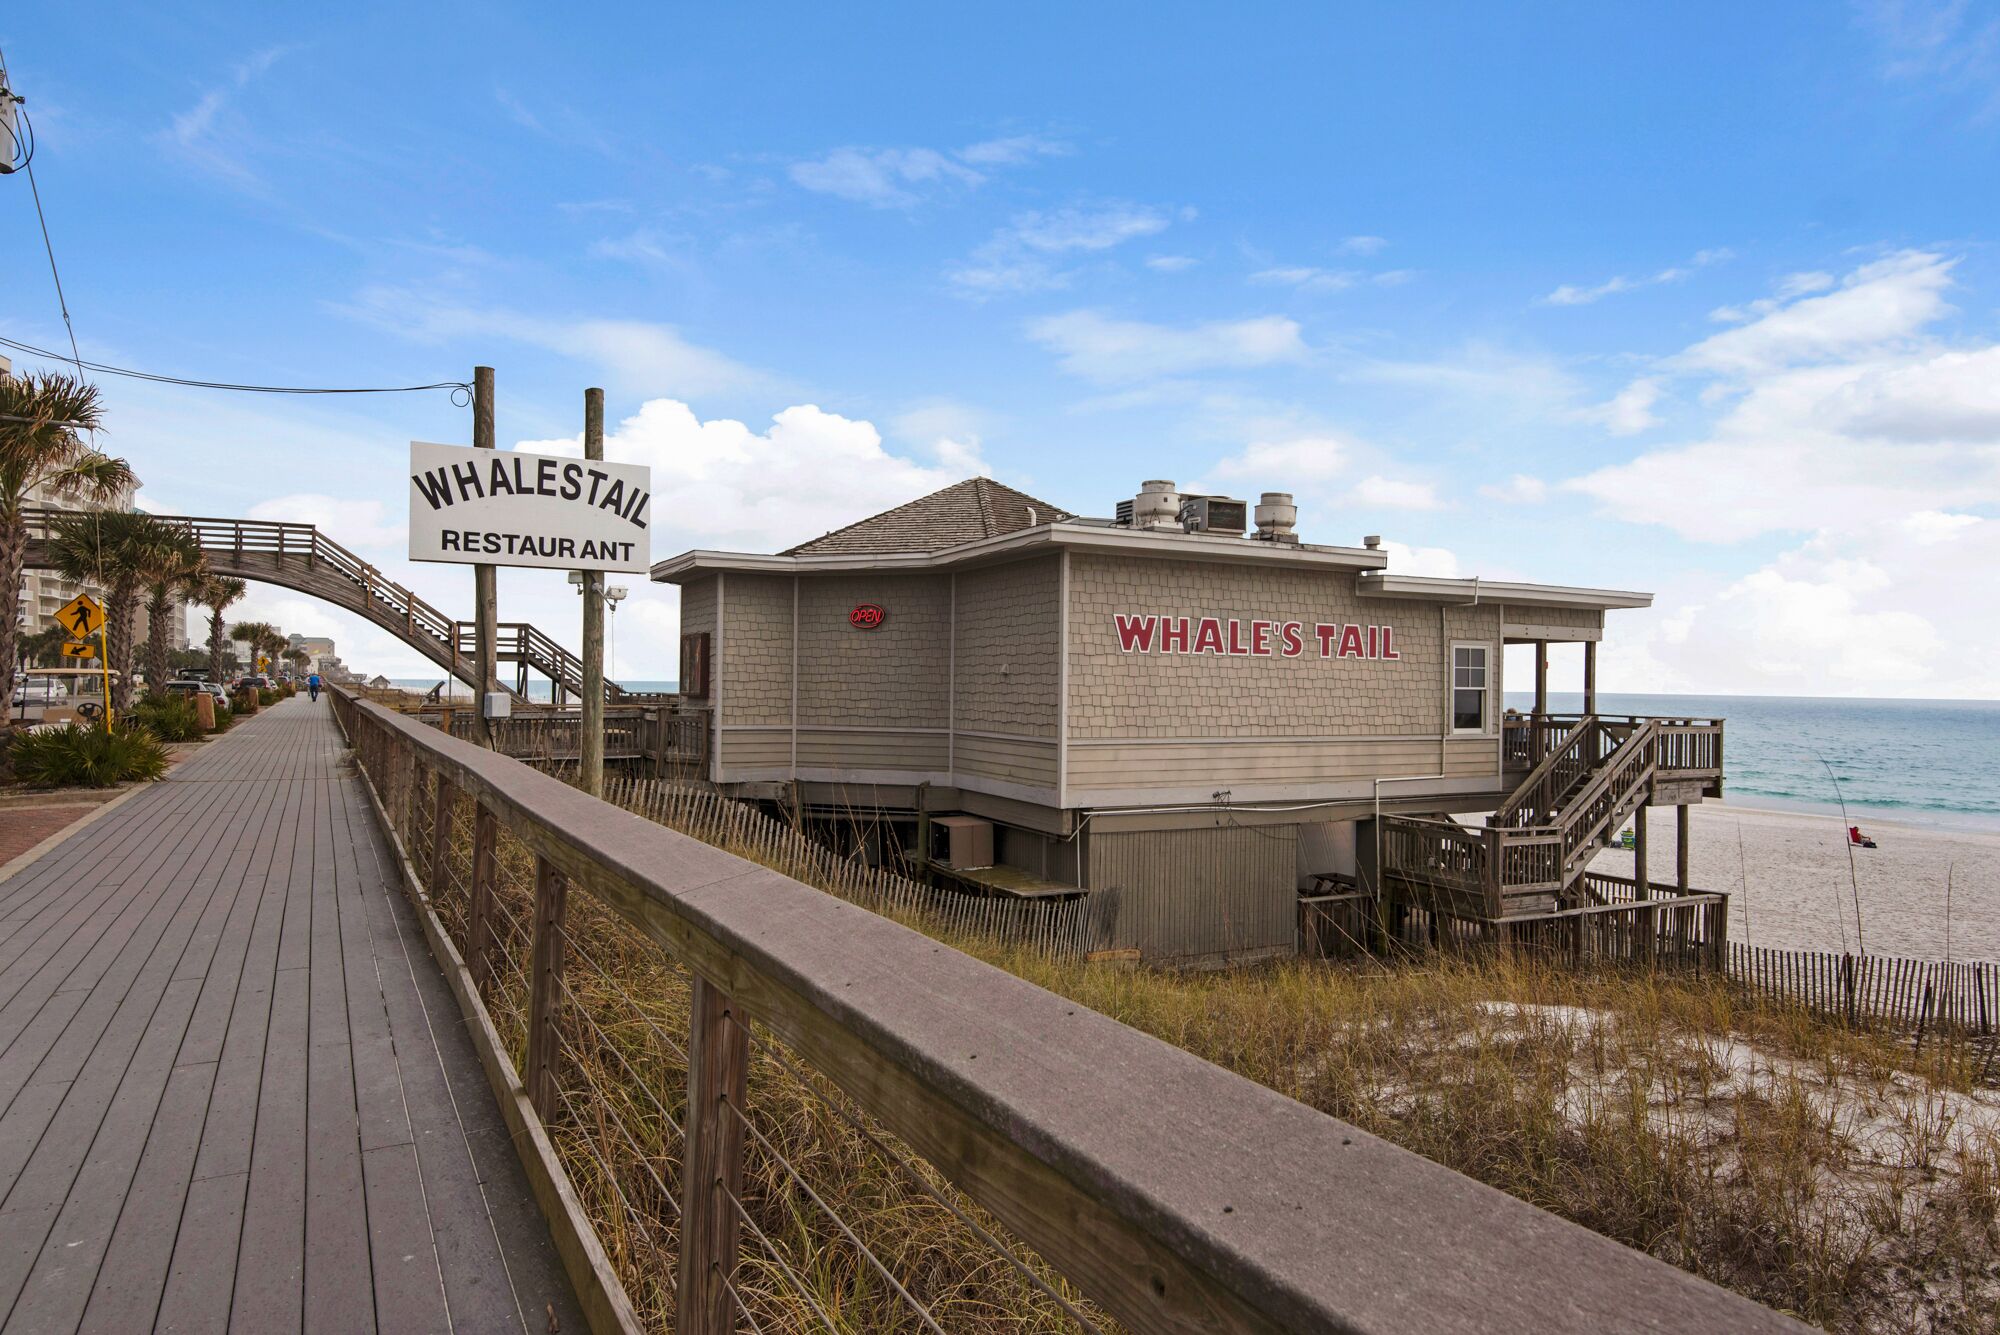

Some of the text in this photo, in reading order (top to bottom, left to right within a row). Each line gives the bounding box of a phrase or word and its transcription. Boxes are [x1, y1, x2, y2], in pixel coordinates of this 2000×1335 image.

[411, 457, 651, 530] WHALESTAIL
[441, 529, 636, 562] RESTAURANT
[851, 608, 882, 623] OPEN
[1113, 613, 1400, 660] WHALE'S TAIL
